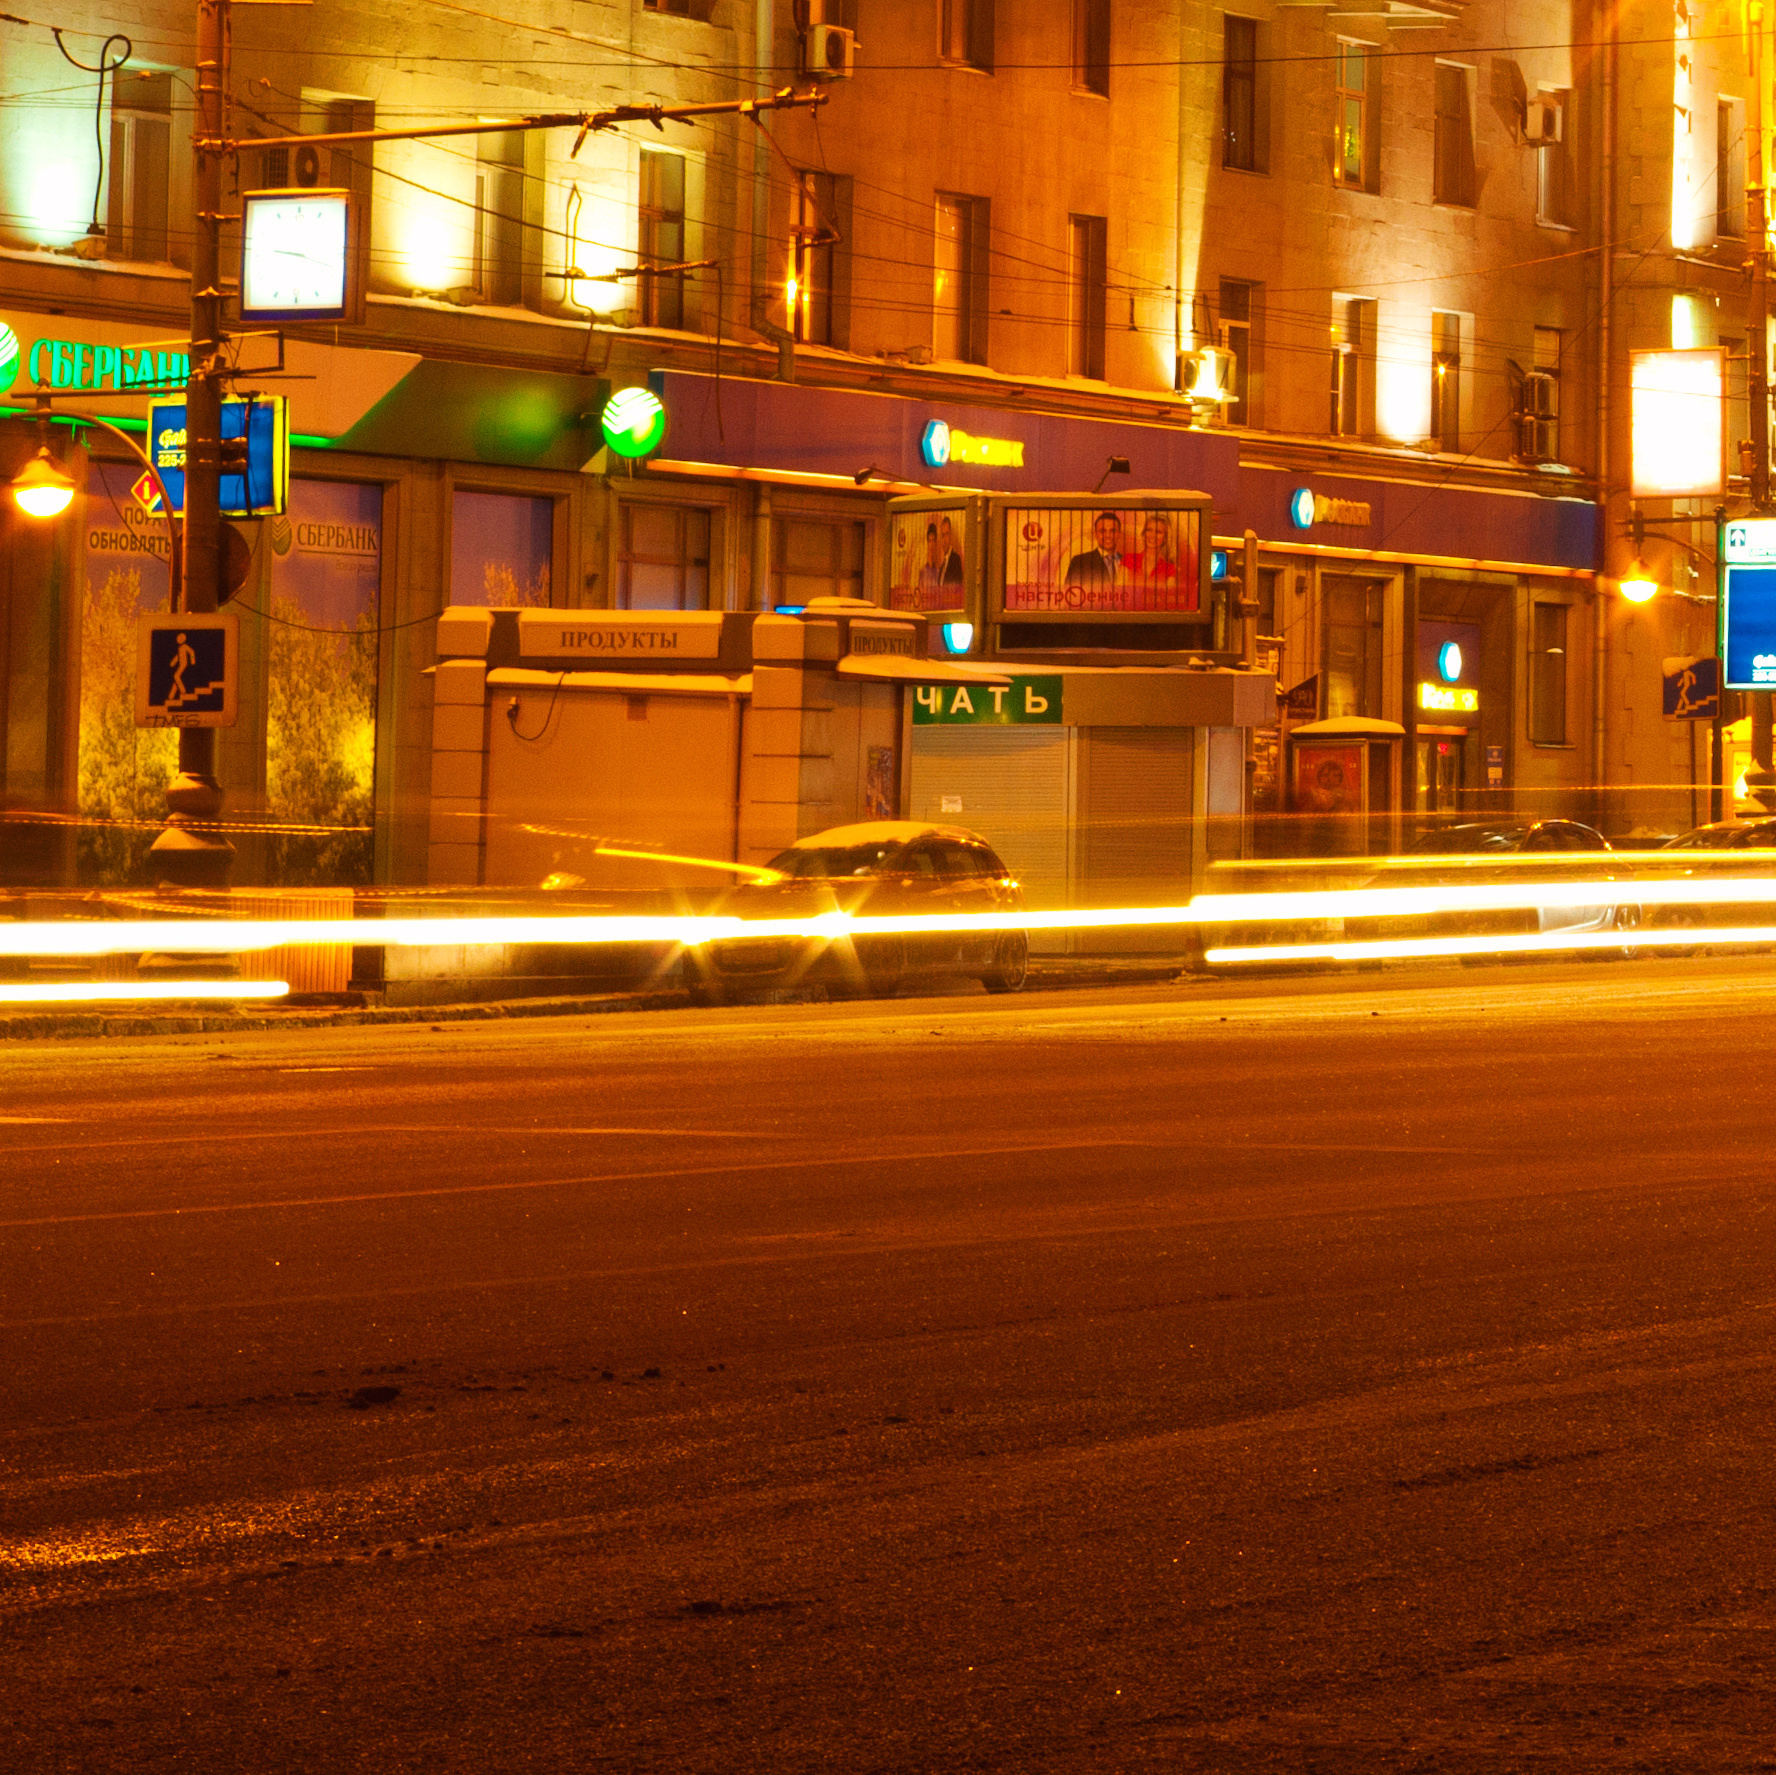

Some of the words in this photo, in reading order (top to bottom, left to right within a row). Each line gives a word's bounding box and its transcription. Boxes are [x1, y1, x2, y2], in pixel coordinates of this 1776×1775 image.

[89, 529, 173, 554] ОБНОВЛЯТЬ
[297, 522, 378, 551] СБЕРБАНК
[560, 631, 678, 650] ПРОДУКТЫ
[853, 635, 914, 655] ПРОДУКТЫ
